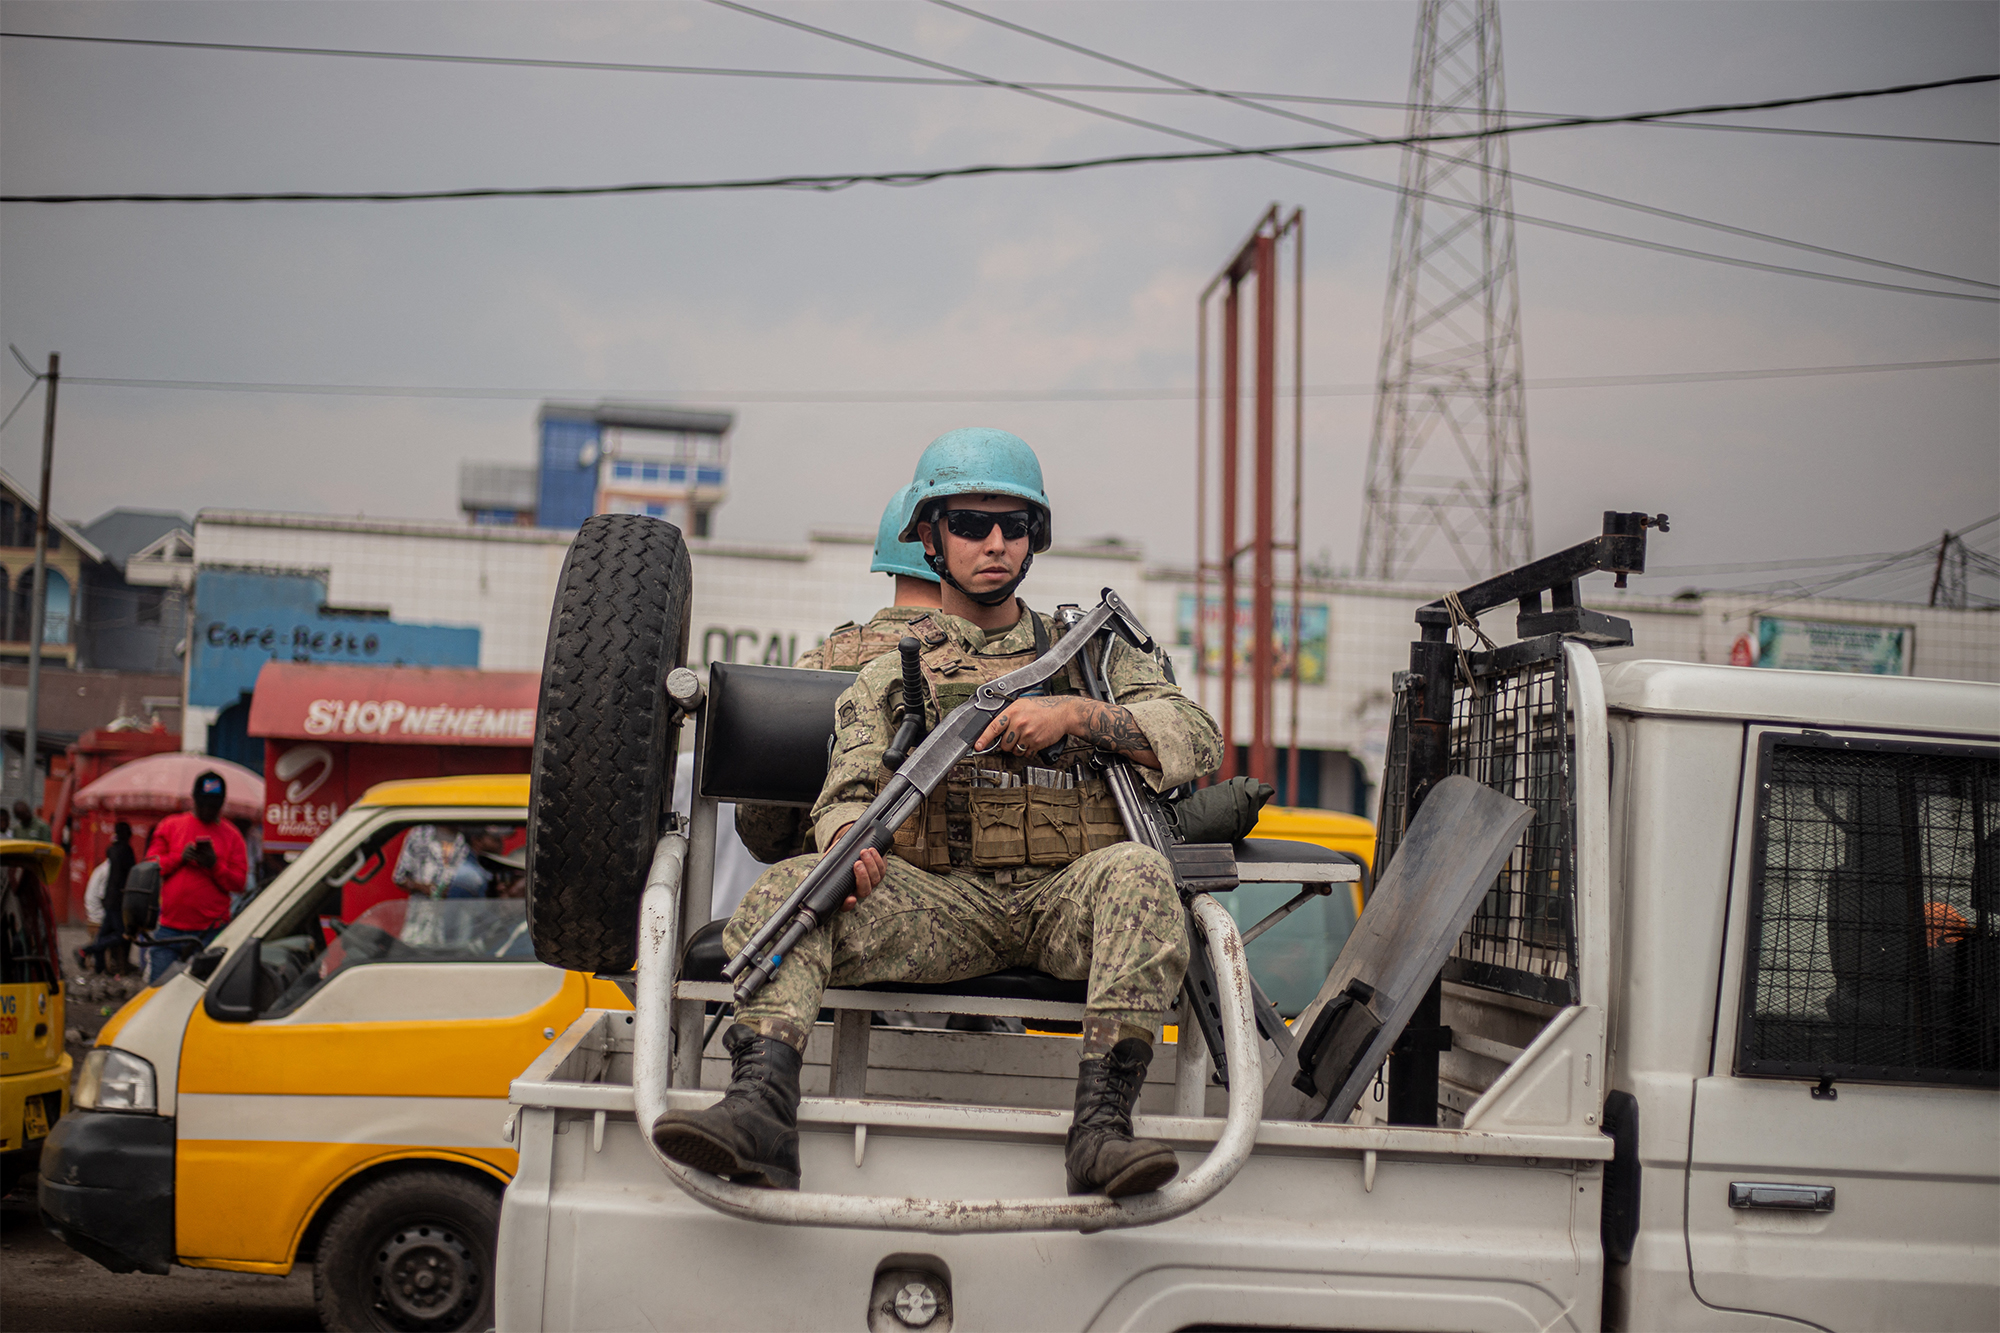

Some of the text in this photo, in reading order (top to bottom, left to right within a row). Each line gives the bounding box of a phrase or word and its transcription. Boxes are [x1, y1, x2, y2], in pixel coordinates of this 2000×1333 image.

[304, 699, 537, 738] SHOP NÉHÉMIE
[266, 800, 339, 826] airtel
